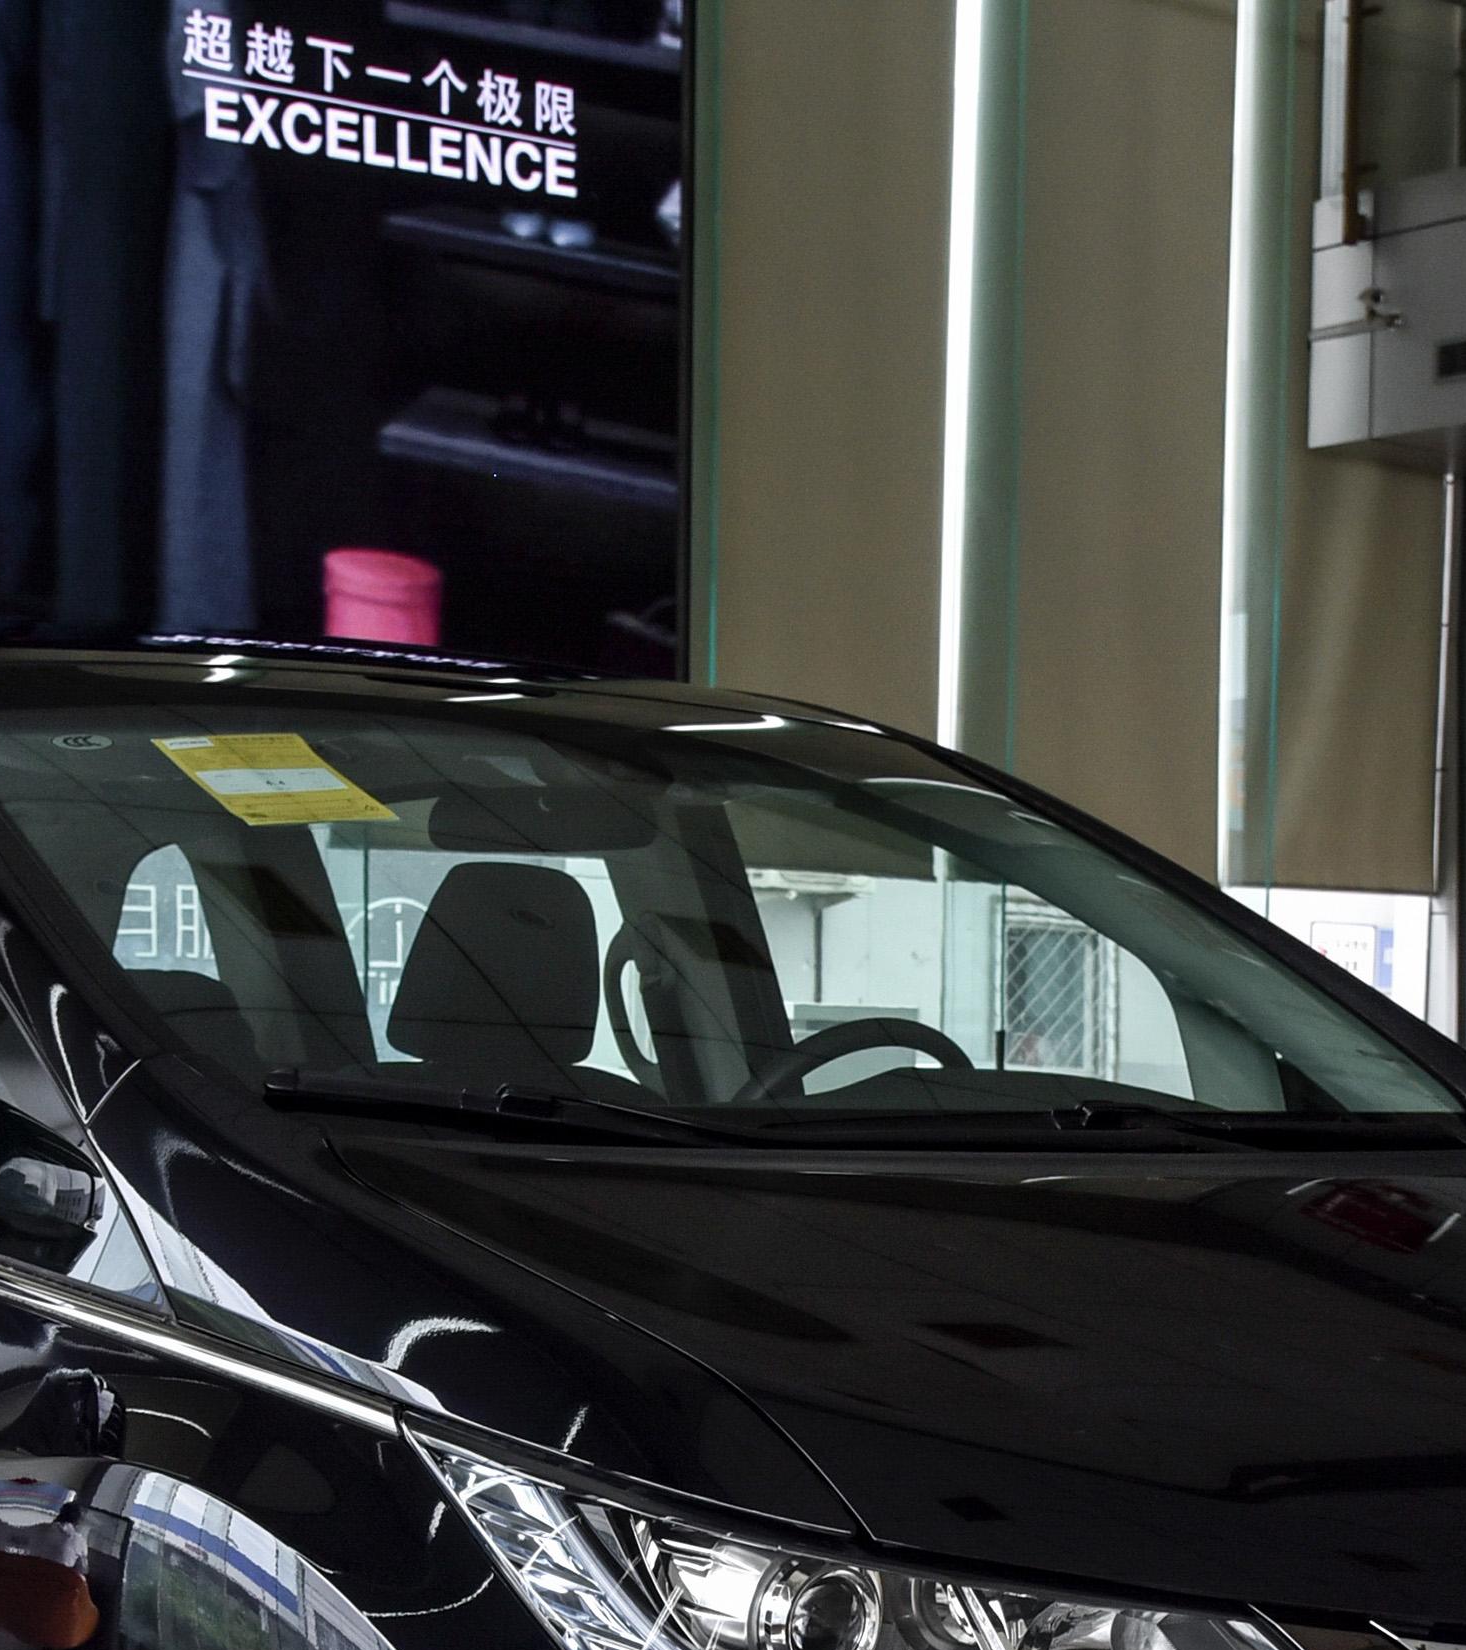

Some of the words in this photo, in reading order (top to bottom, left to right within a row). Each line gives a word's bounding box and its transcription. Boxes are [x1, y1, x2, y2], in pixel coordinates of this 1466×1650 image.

[182, 8, 577, 137] 超越下一个极限
[204, 87, 578, 198] EXCELLENCE
